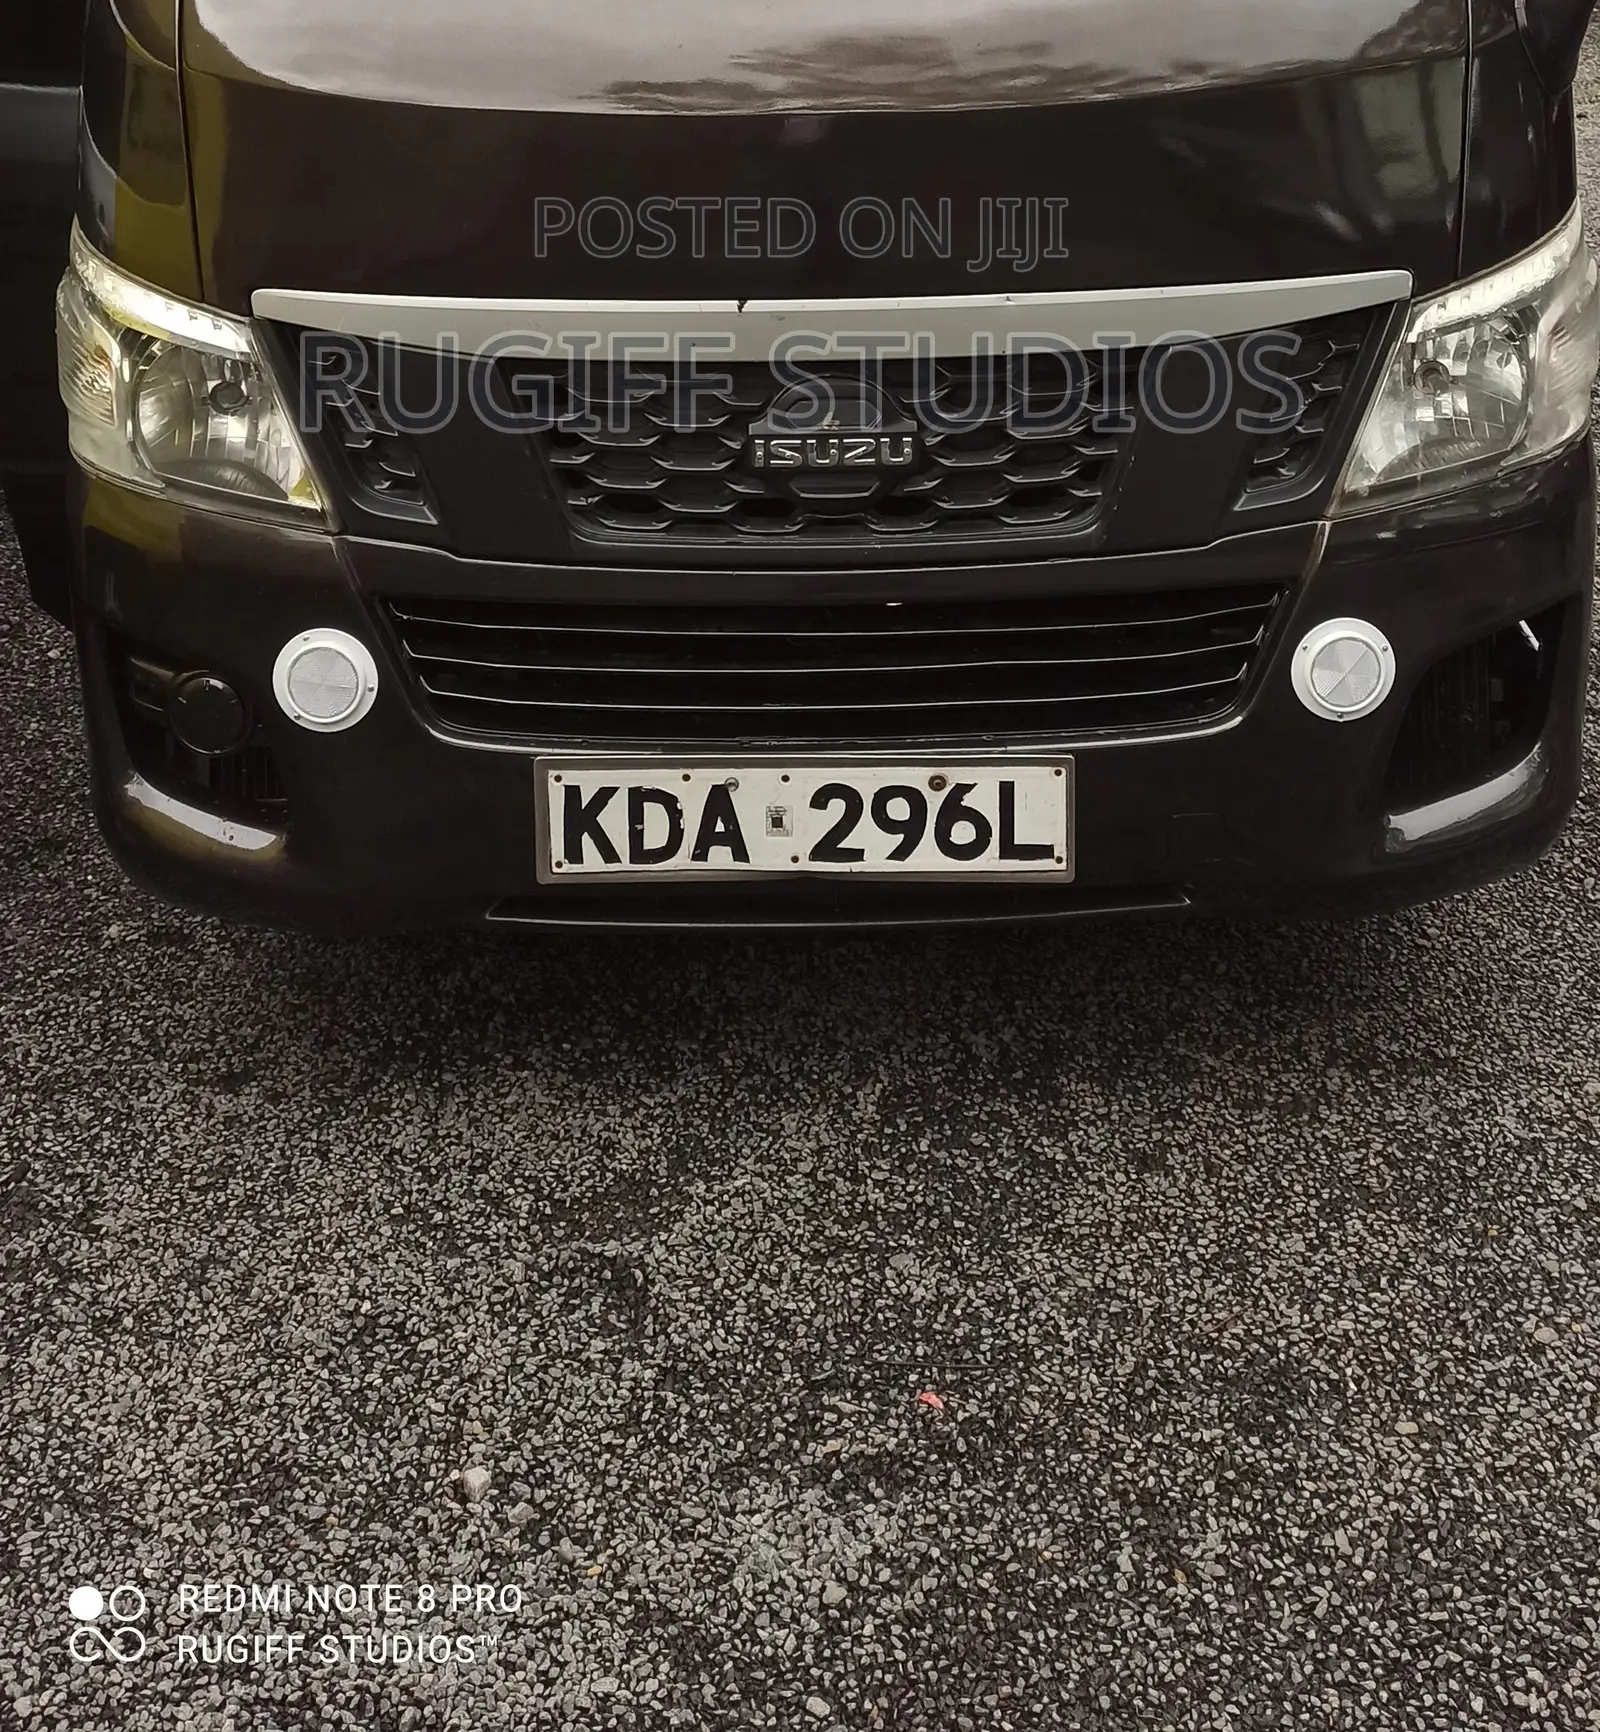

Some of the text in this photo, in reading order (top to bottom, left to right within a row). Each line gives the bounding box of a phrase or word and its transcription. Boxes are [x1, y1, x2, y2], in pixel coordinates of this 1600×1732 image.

[754, 437, 913, 467] ISUZU
[563, 780, 1055, 865] KDA 296L
